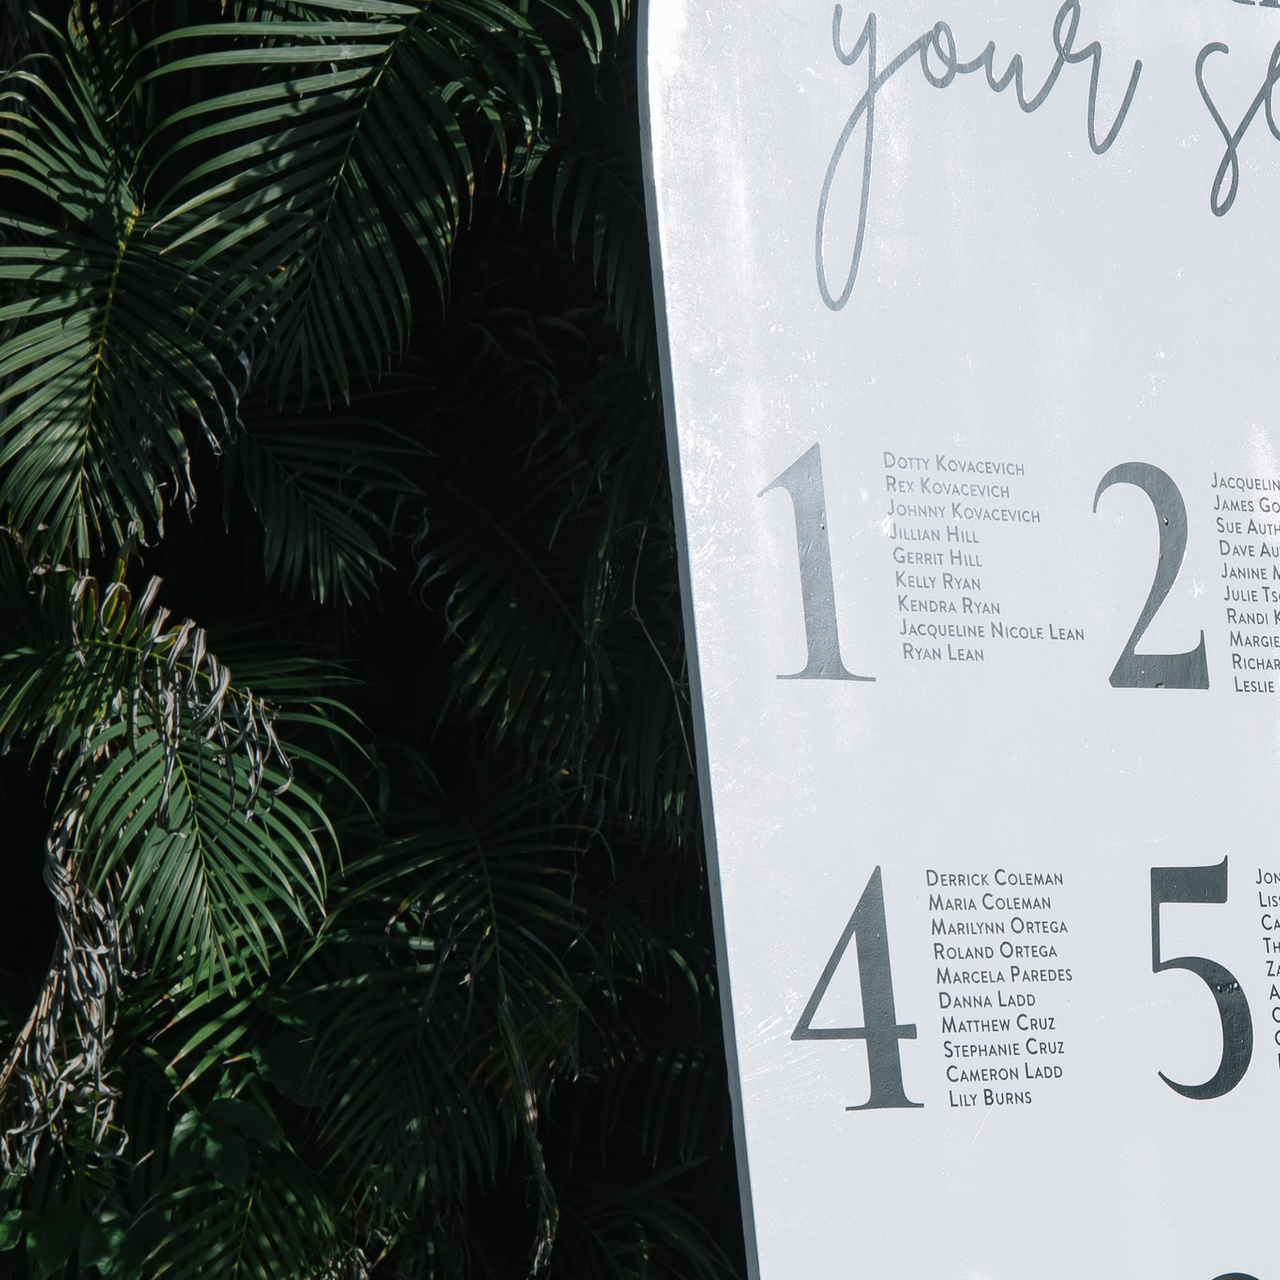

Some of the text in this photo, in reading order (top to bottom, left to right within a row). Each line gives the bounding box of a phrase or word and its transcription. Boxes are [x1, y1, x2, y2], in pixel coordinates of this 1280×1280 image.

[1216, 517, 1242, 534] SUE
[757, 442, 877, 682] 1
[1221, 562, 1267, 580] JANINE
[1093, 462, 1210, 690] 2
[1224, 585, 1258, 602] JULIE
[1227, 607, 1268, 625] RANDI
[1230, 630, 1280, 648] MARGIE
[926, 868, 1063, 887] DERRICK COLEMAN
[929, 893, 1051, 911] MARIA COLEMAN
[934, 941, 1058, 960] ROLAND ORTEGA
[937, 965, 1072, 984] MARCELA PAREDES
[1150, 855, 1253, 1100] 5
[790, 865, 924, 1111] 4
[942, 1013, 1055, 1033] MATTHEW CRUZ
[943, 1037, 1064, 1058] STEPHANIE CRUZ
[949, 1088, 1032, 1107] LILY BURNS
